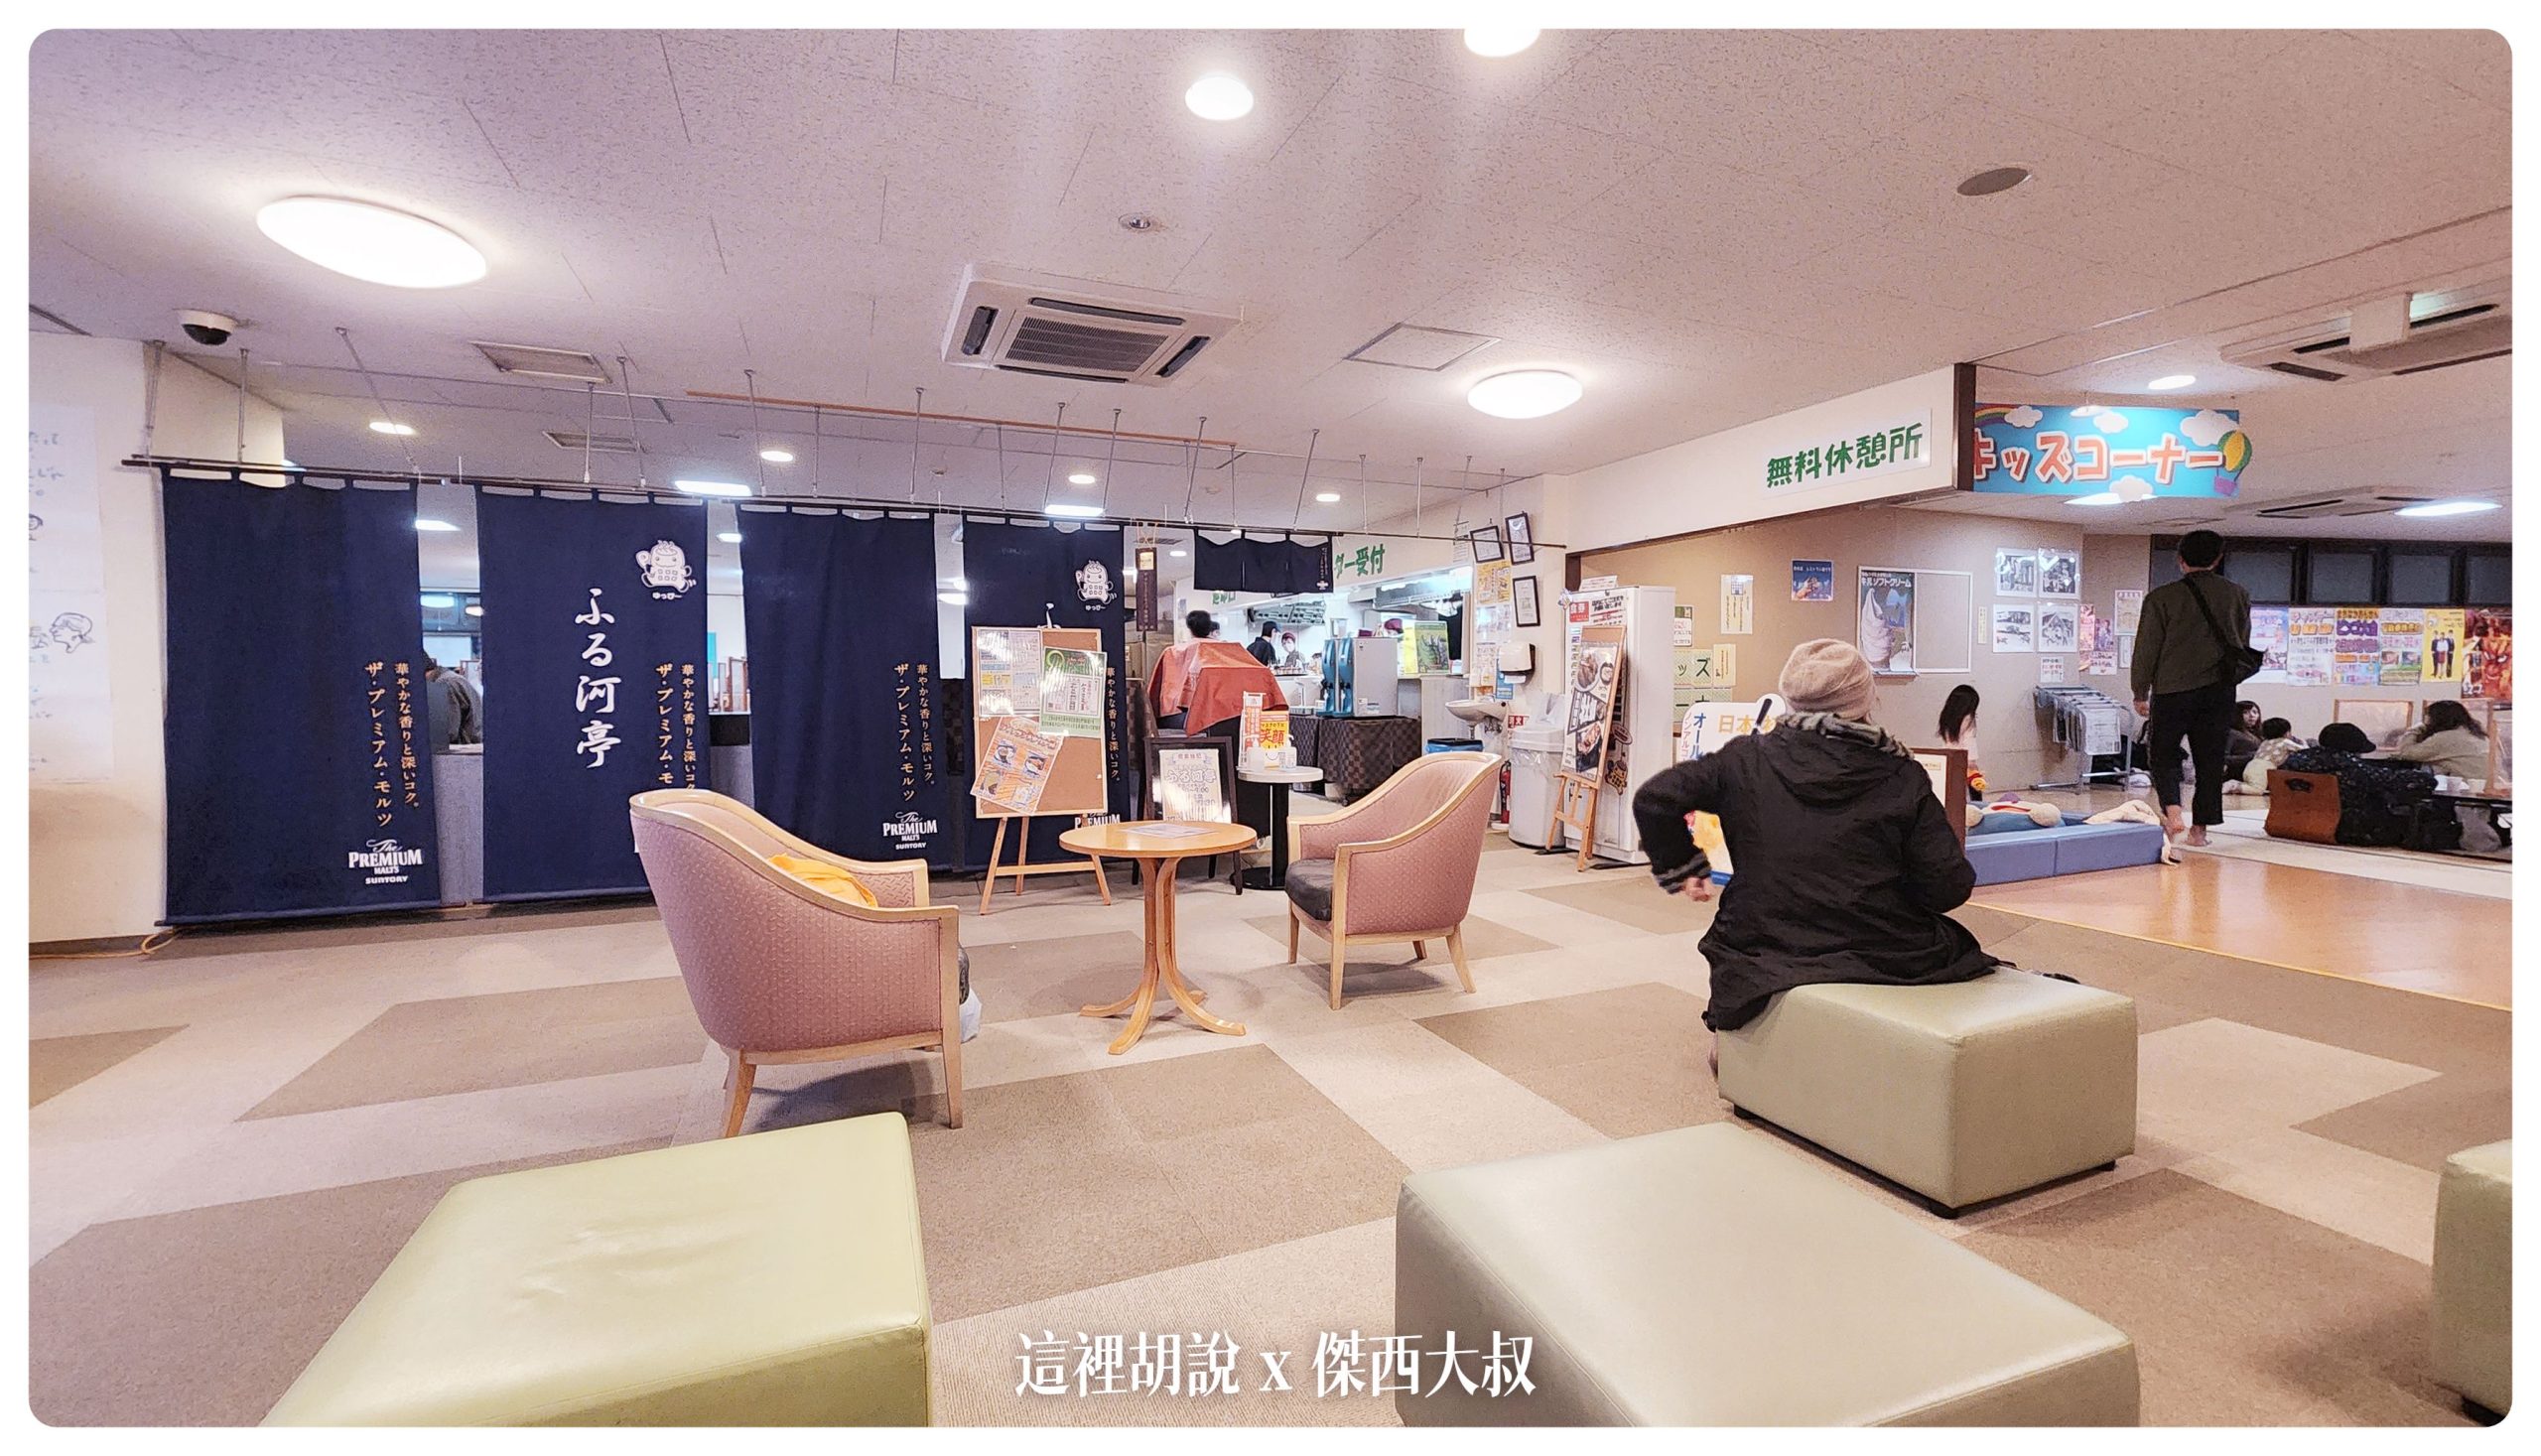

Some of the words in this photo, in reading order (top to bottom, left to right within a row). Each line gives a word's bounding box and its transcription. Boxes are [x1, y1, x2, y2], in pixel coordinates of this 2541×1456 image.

[1767, 422, 1924, 488] 無料休憩所
[1974, 428, 2224, 484] キッズコーナー
[575, 588, 621, 768] ふる河亭
[394, 662, 419, 808] 華やかな香りと深いコク。
[894, 663, 914, 801] ザ・プレミアム・モルツ
[916, 664, 935, 785] 華やかな香りと深いコク。
[1261, 728, 1284, 743] 笑顔
[364, 661, 392, 827] ザ・プレミアム・モルツ
[882, 820, 937, 836] PREMIUM
[895, 811, 923, 823] The
[1074, 814, 1120, 830] PEMIUM
[348, 849, 423, 868] PREMIUM
[366, 839, 403, 853] The
[365, 875, 408, 884] SUNTORY
